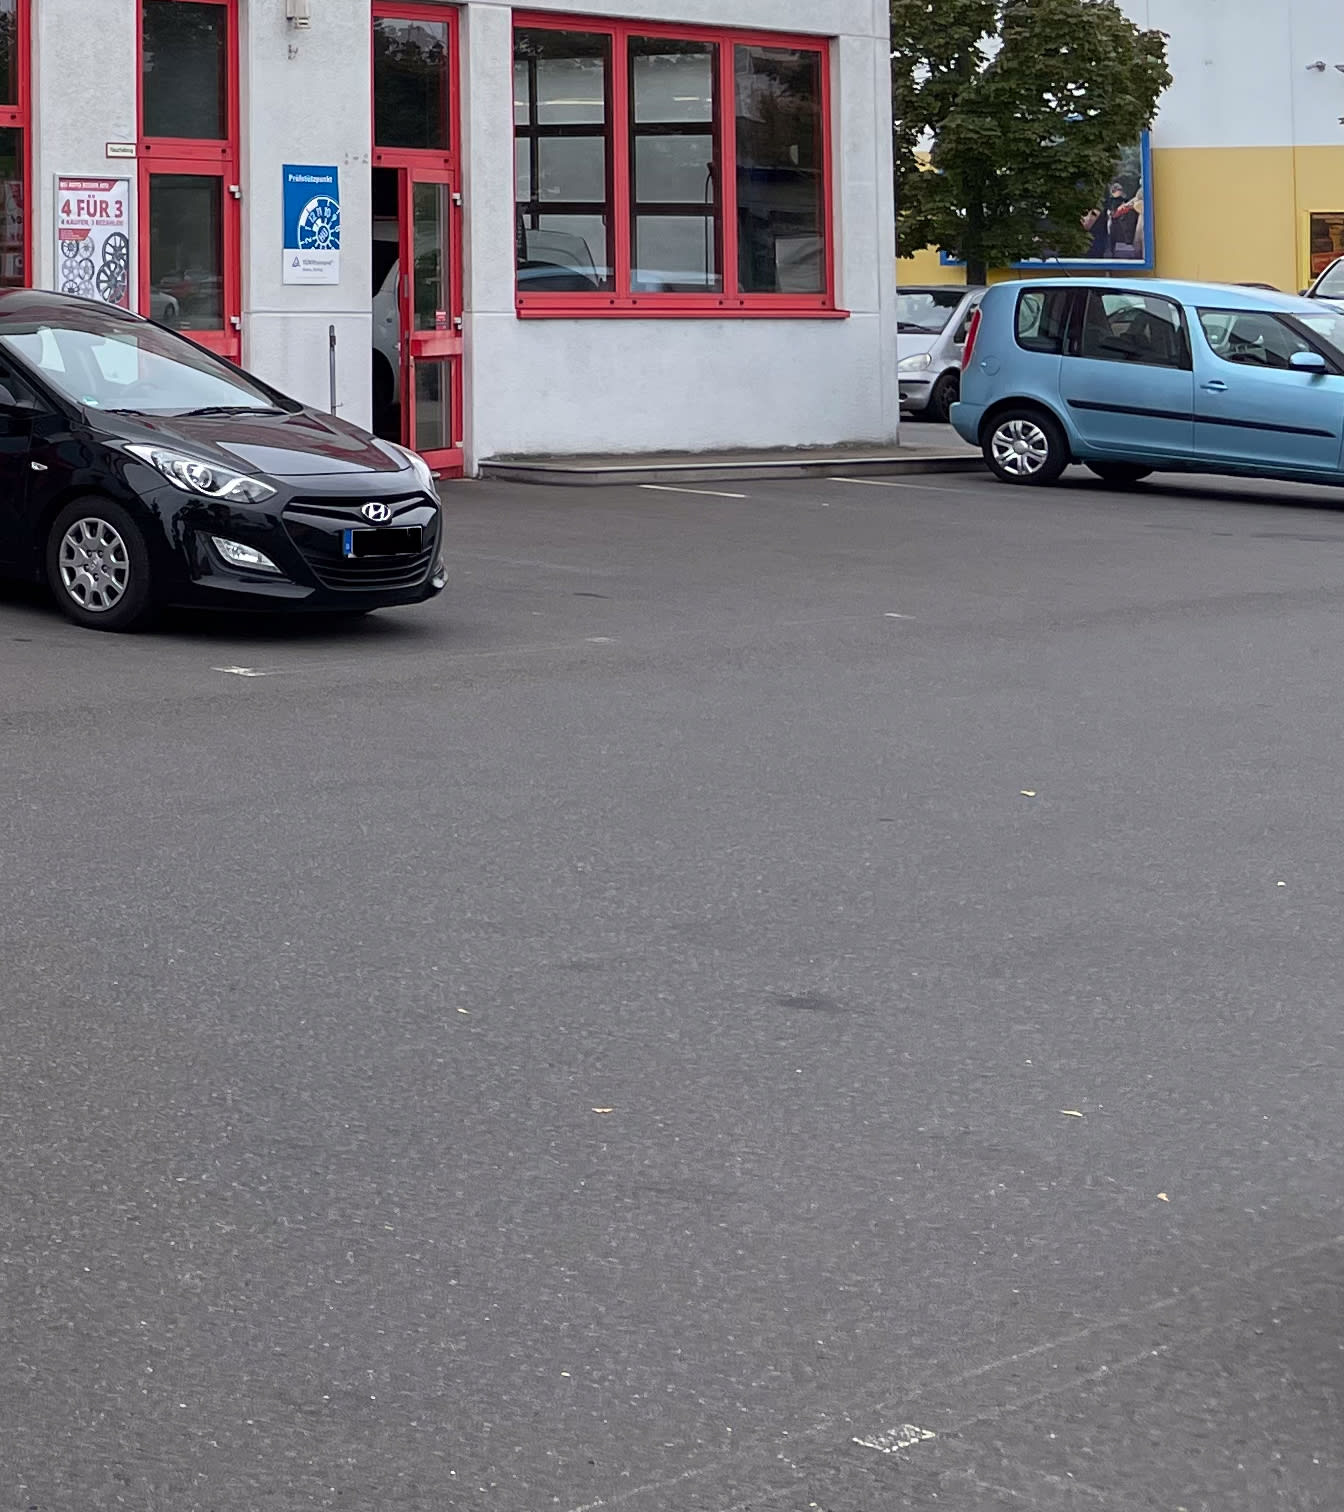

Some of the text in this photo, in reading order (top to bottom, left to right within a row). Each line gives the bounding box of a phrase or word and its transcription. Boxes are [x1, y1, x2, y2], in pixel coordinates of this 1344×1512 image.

[61, 194, 123, 218] 4 FÜR 3
